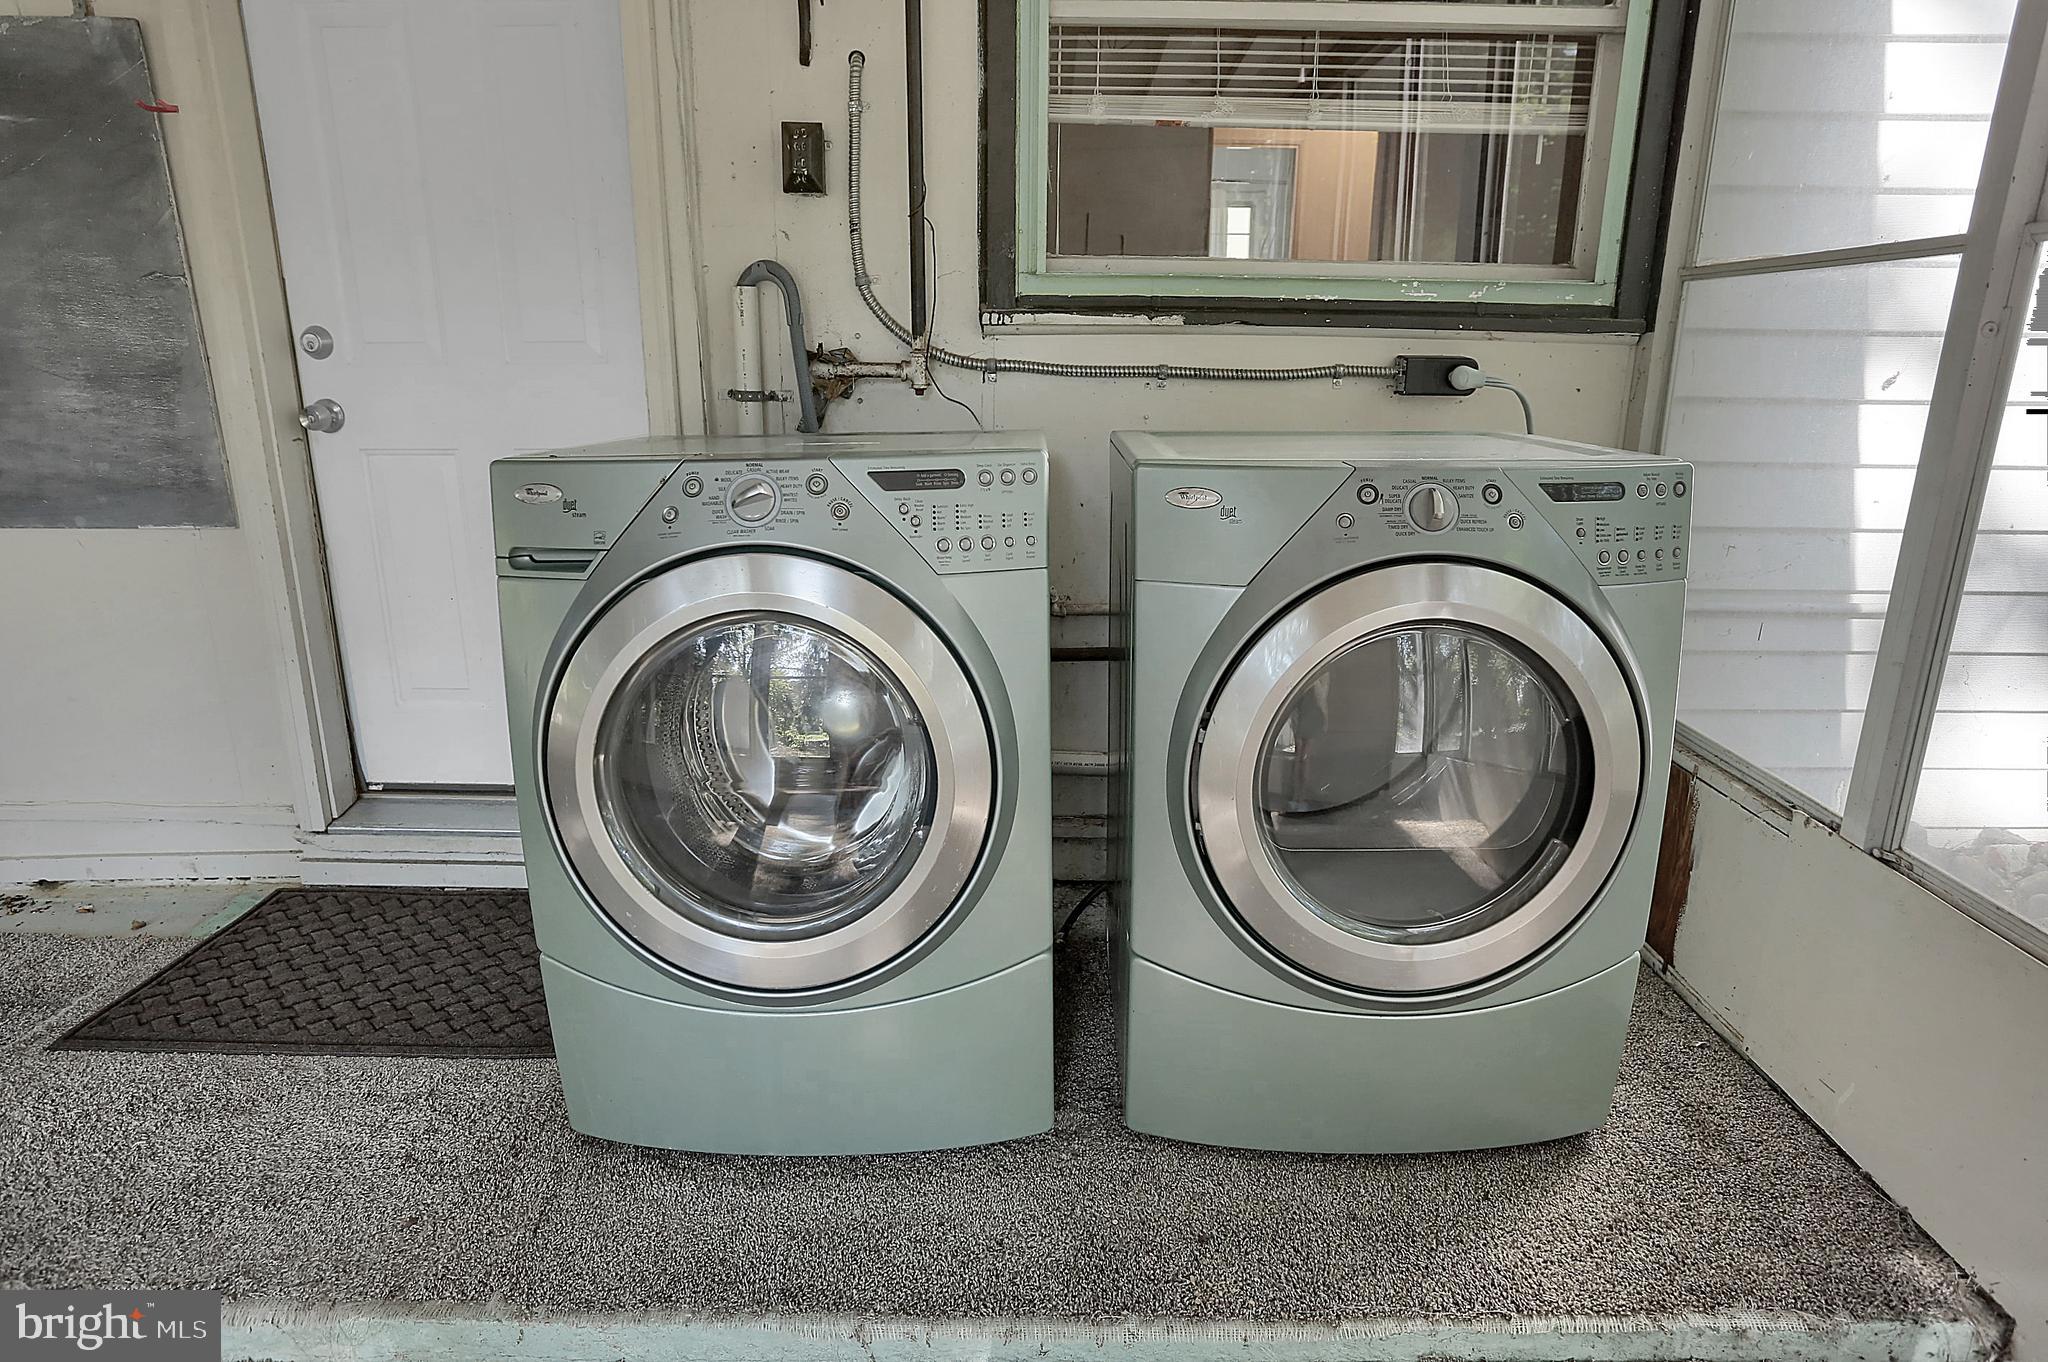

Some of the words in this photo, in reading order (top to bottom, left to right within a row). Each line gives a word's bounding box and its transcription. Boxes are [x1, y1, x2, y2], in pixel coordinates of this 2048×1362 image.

[525, 488, 548, 498] Whirlpool
[1178, 492, 1208, 502] Whirlpool
[1220, 505, 1237, 518] duet
